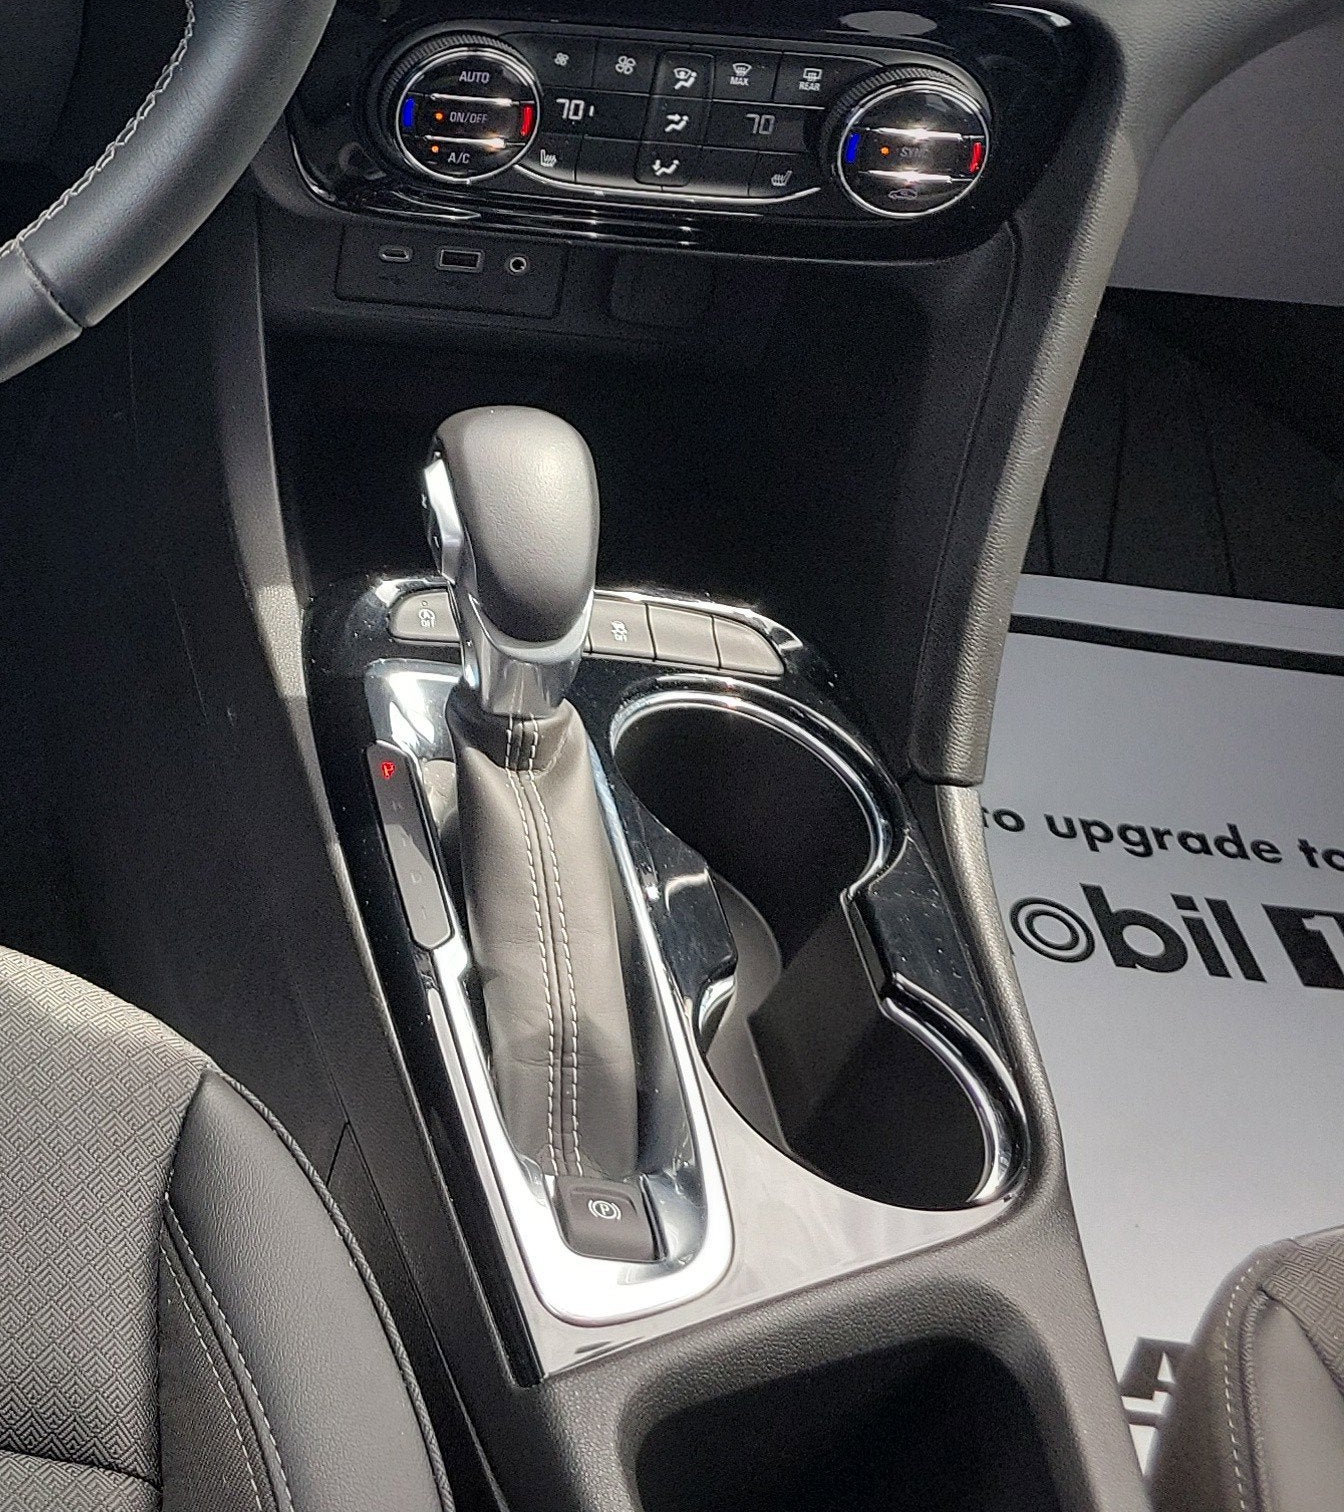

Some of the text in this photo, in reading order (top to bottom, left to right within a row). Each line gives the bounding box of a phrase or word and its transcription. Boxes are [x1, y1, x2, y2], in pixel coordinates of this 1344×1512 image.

[458, 70, 491, 84] AUTO
[729, 75, 750, 87] MAX
[798, 81, 821, 93] REAR
[448, 110, 489, 125] ON/OFF
[745, 113, 776, 135] 70
[447, 151, 472, 165] A/C
[1043, 812, 1283, 866] upgrade
[1298, 838, 1344, 873] to
[1010, 882, 1268, 984] obil
